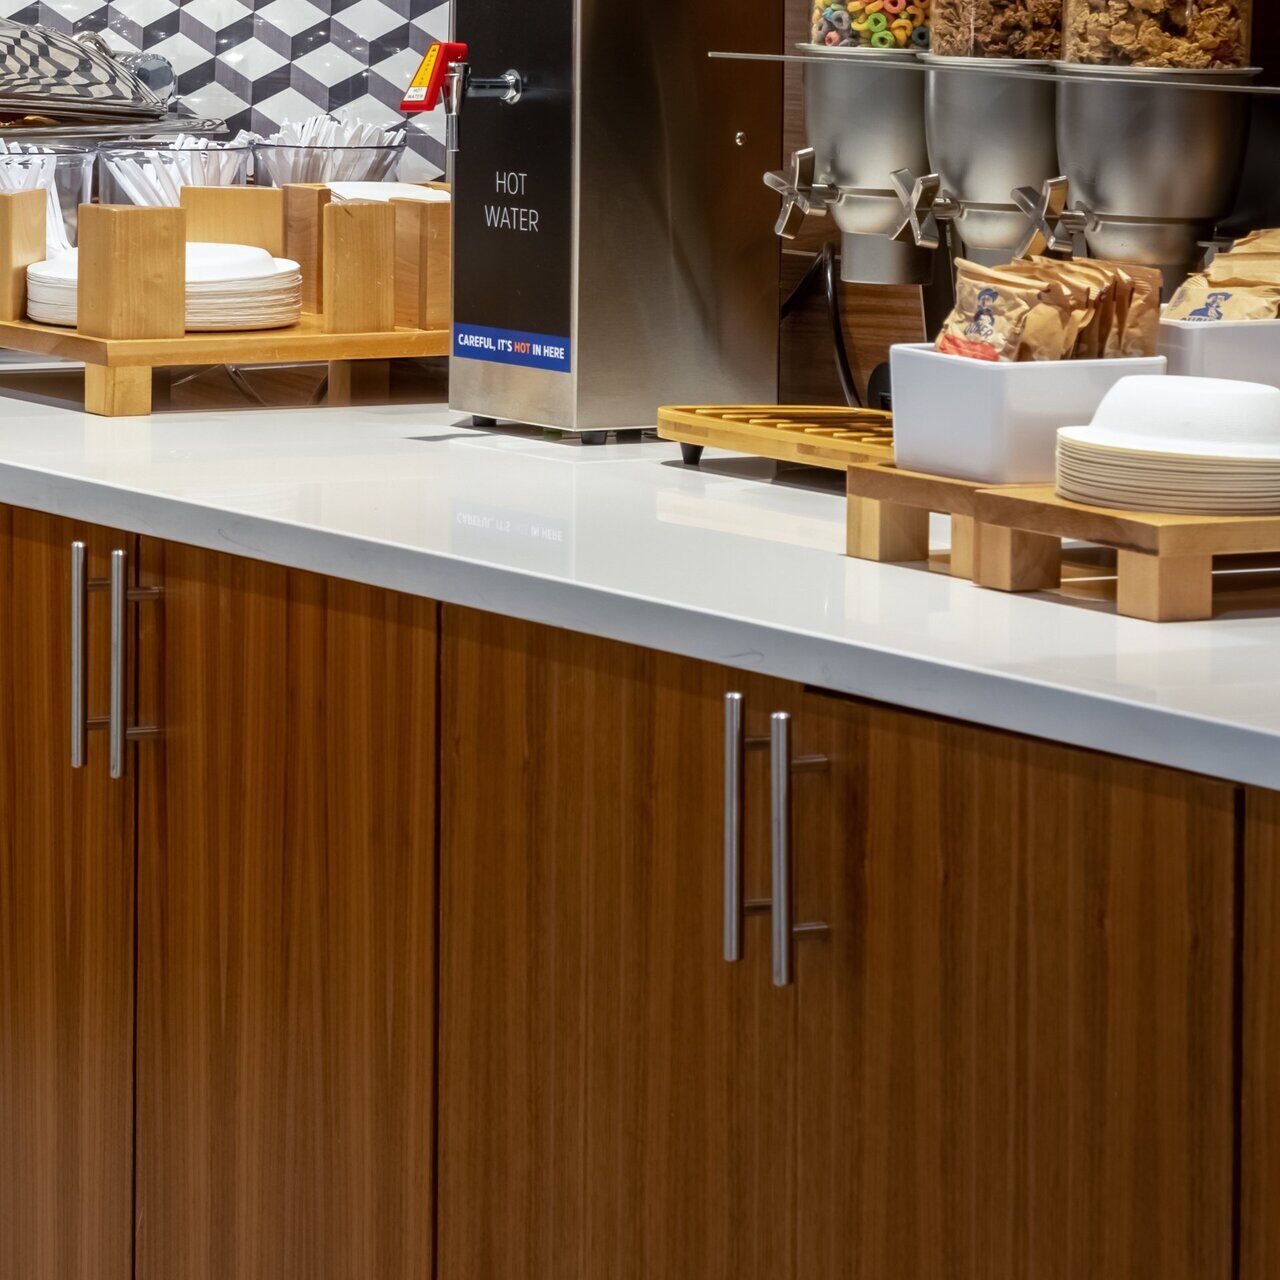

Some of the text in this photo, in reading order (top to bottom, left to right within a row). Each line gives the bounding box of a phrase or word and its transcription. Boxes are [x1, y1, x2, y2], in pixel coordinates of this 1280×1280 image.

[495, 171, 528, 196] HOT
[484, 204, 539, 233] WATER
[458, 333, 565, 359] CAREFUL, IT'S HOT IN HERE
